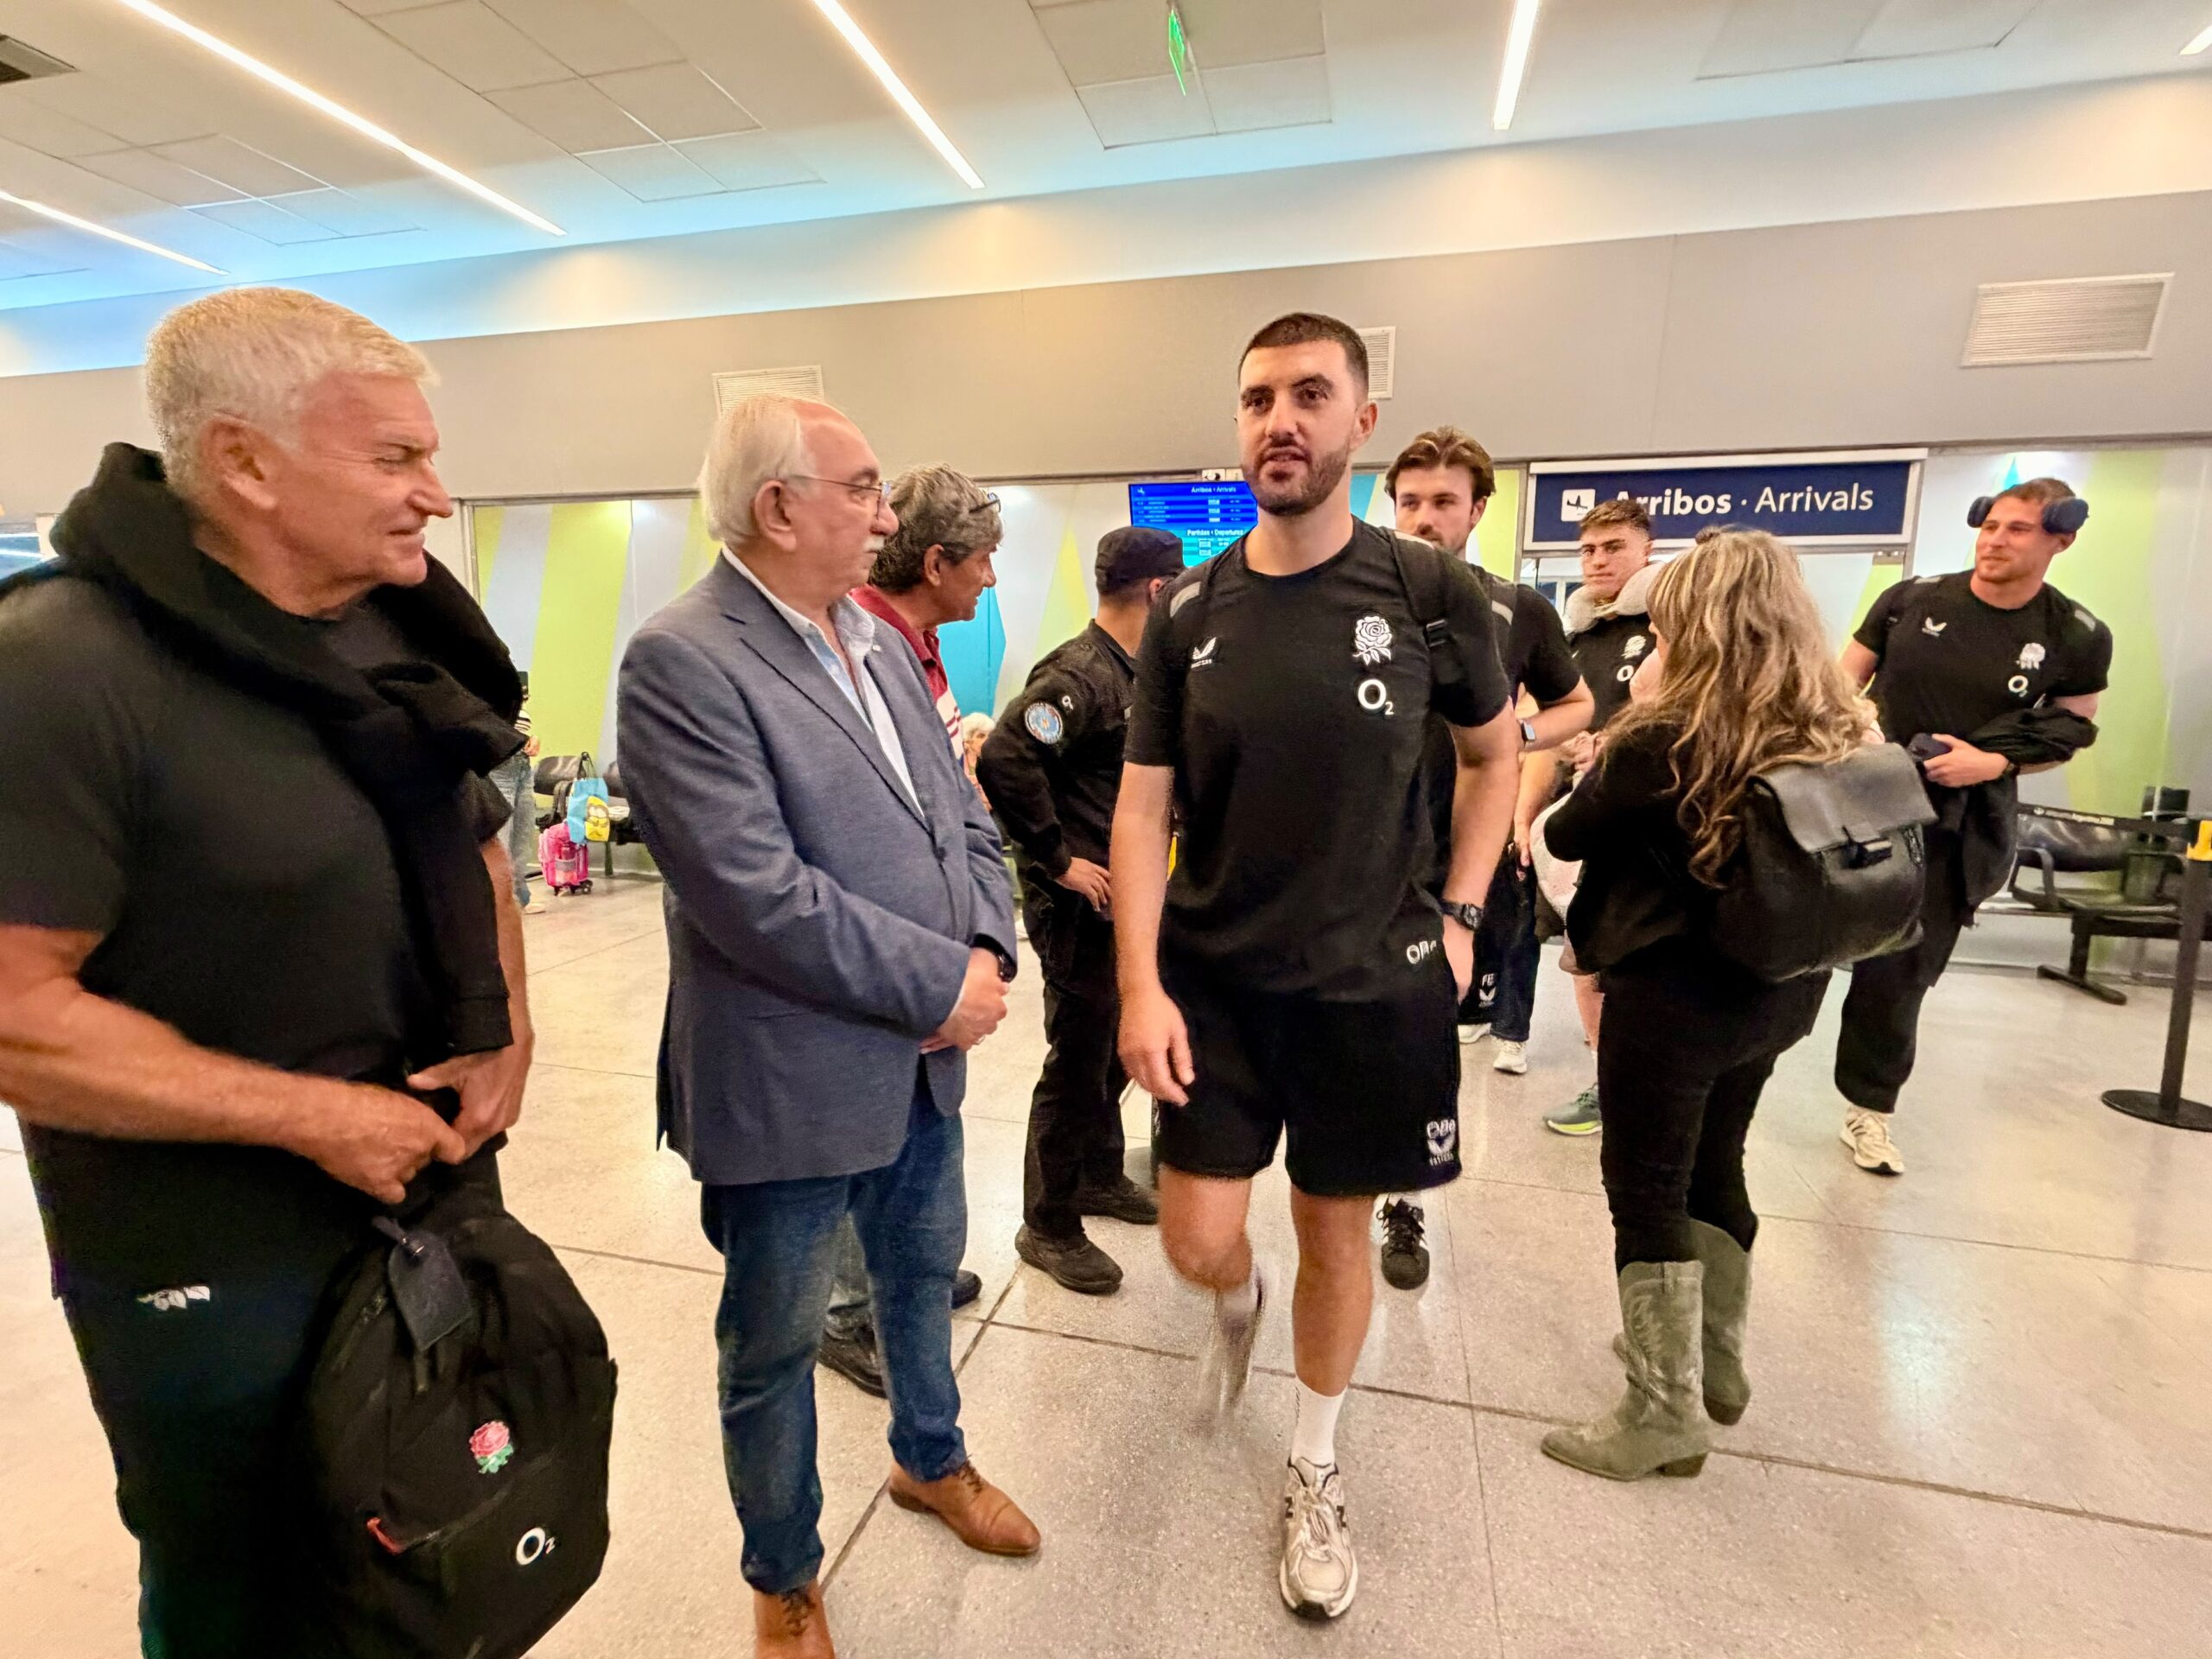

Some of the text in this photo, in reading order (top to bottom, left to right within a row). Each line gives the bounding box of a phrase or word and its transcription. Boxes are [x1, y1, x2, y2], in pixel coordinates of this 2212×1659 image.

[1754, 482, 1874, 513] Arrivals
[1357, 678, 1395, 715] O2
[516, 1527, 556, 1566] O2
